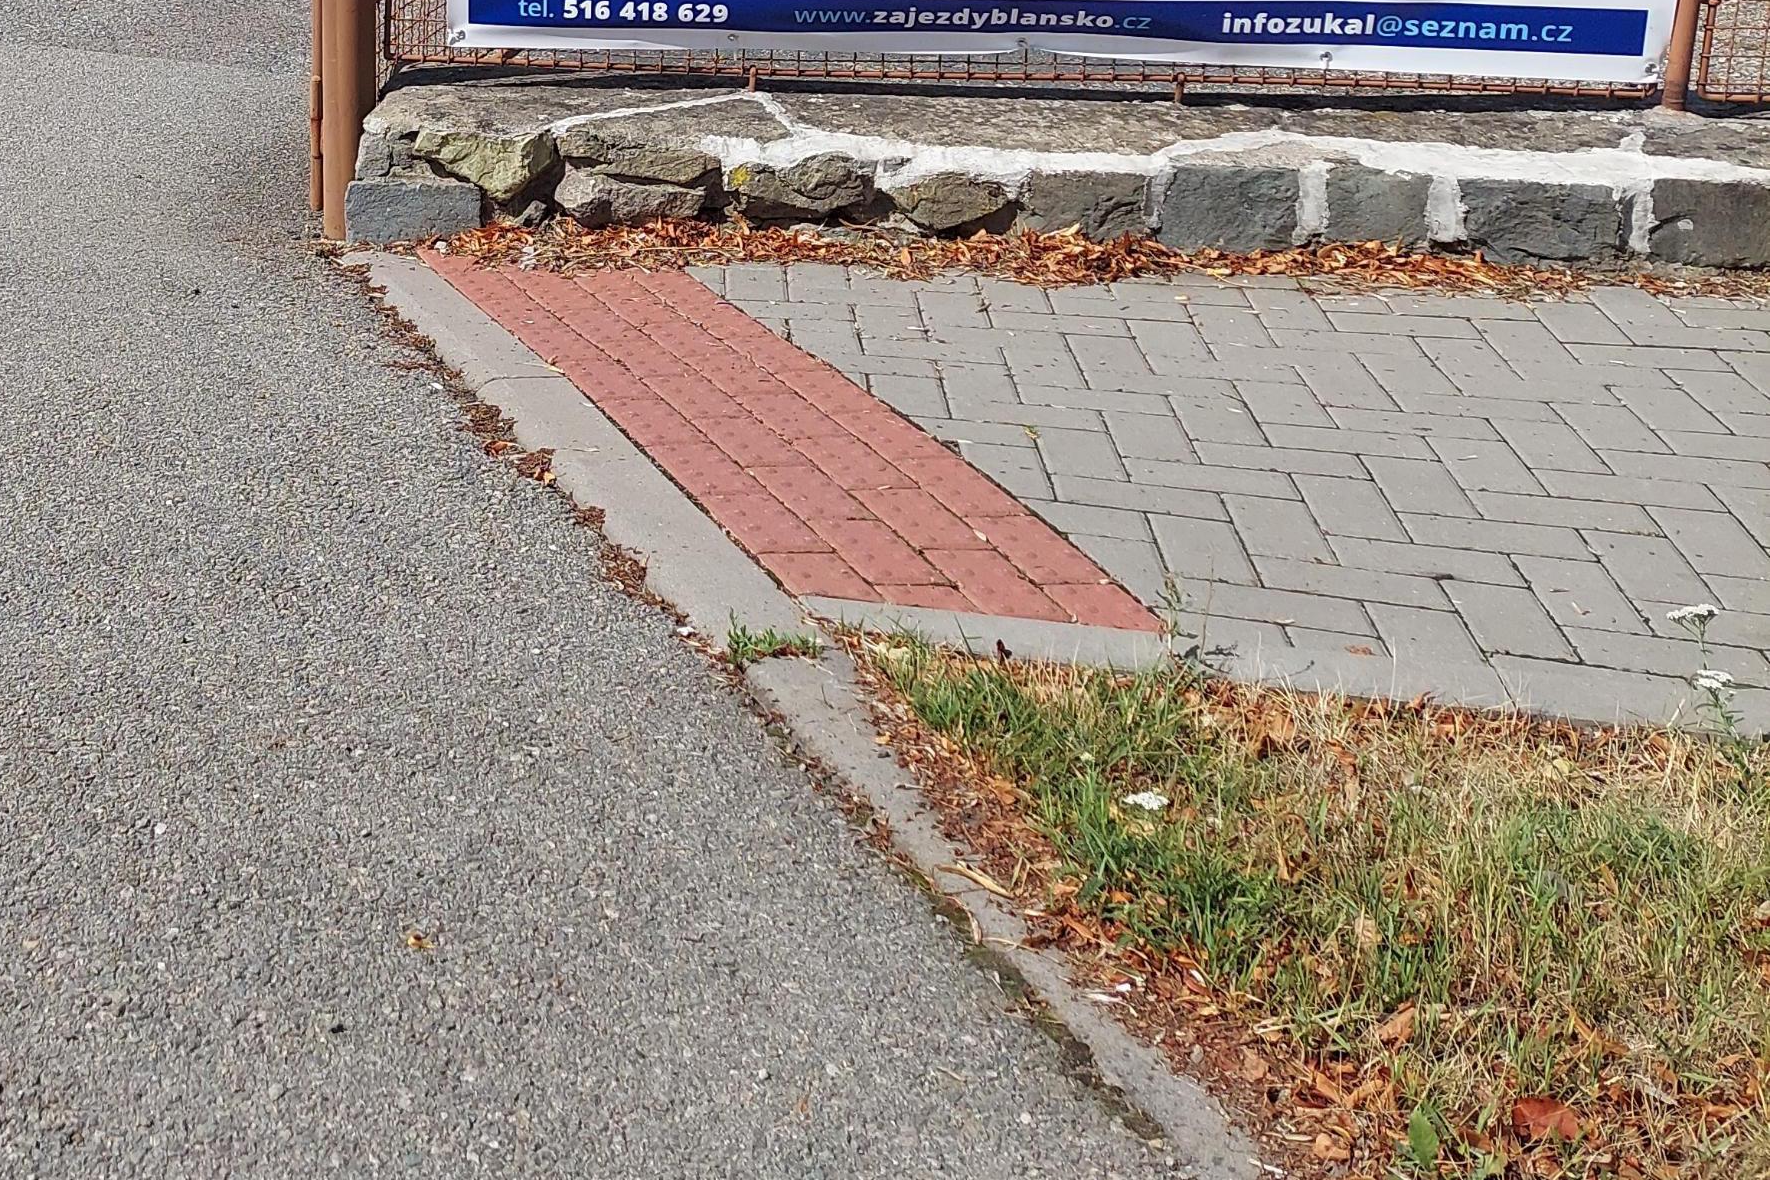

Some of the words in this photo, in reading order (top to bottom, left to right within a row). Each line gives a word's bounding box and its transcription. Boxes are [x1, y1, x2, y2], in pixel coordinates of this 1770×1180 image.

[563, 0, 611, 20] 516
[619, 1, 668, 22] 418
[678, 3, 728, 23] 629
[794, 6, 1152, 31] www.zajezdyblansko.cz
[1221, 12, 1573, 42] infozukal@seznam.cz
